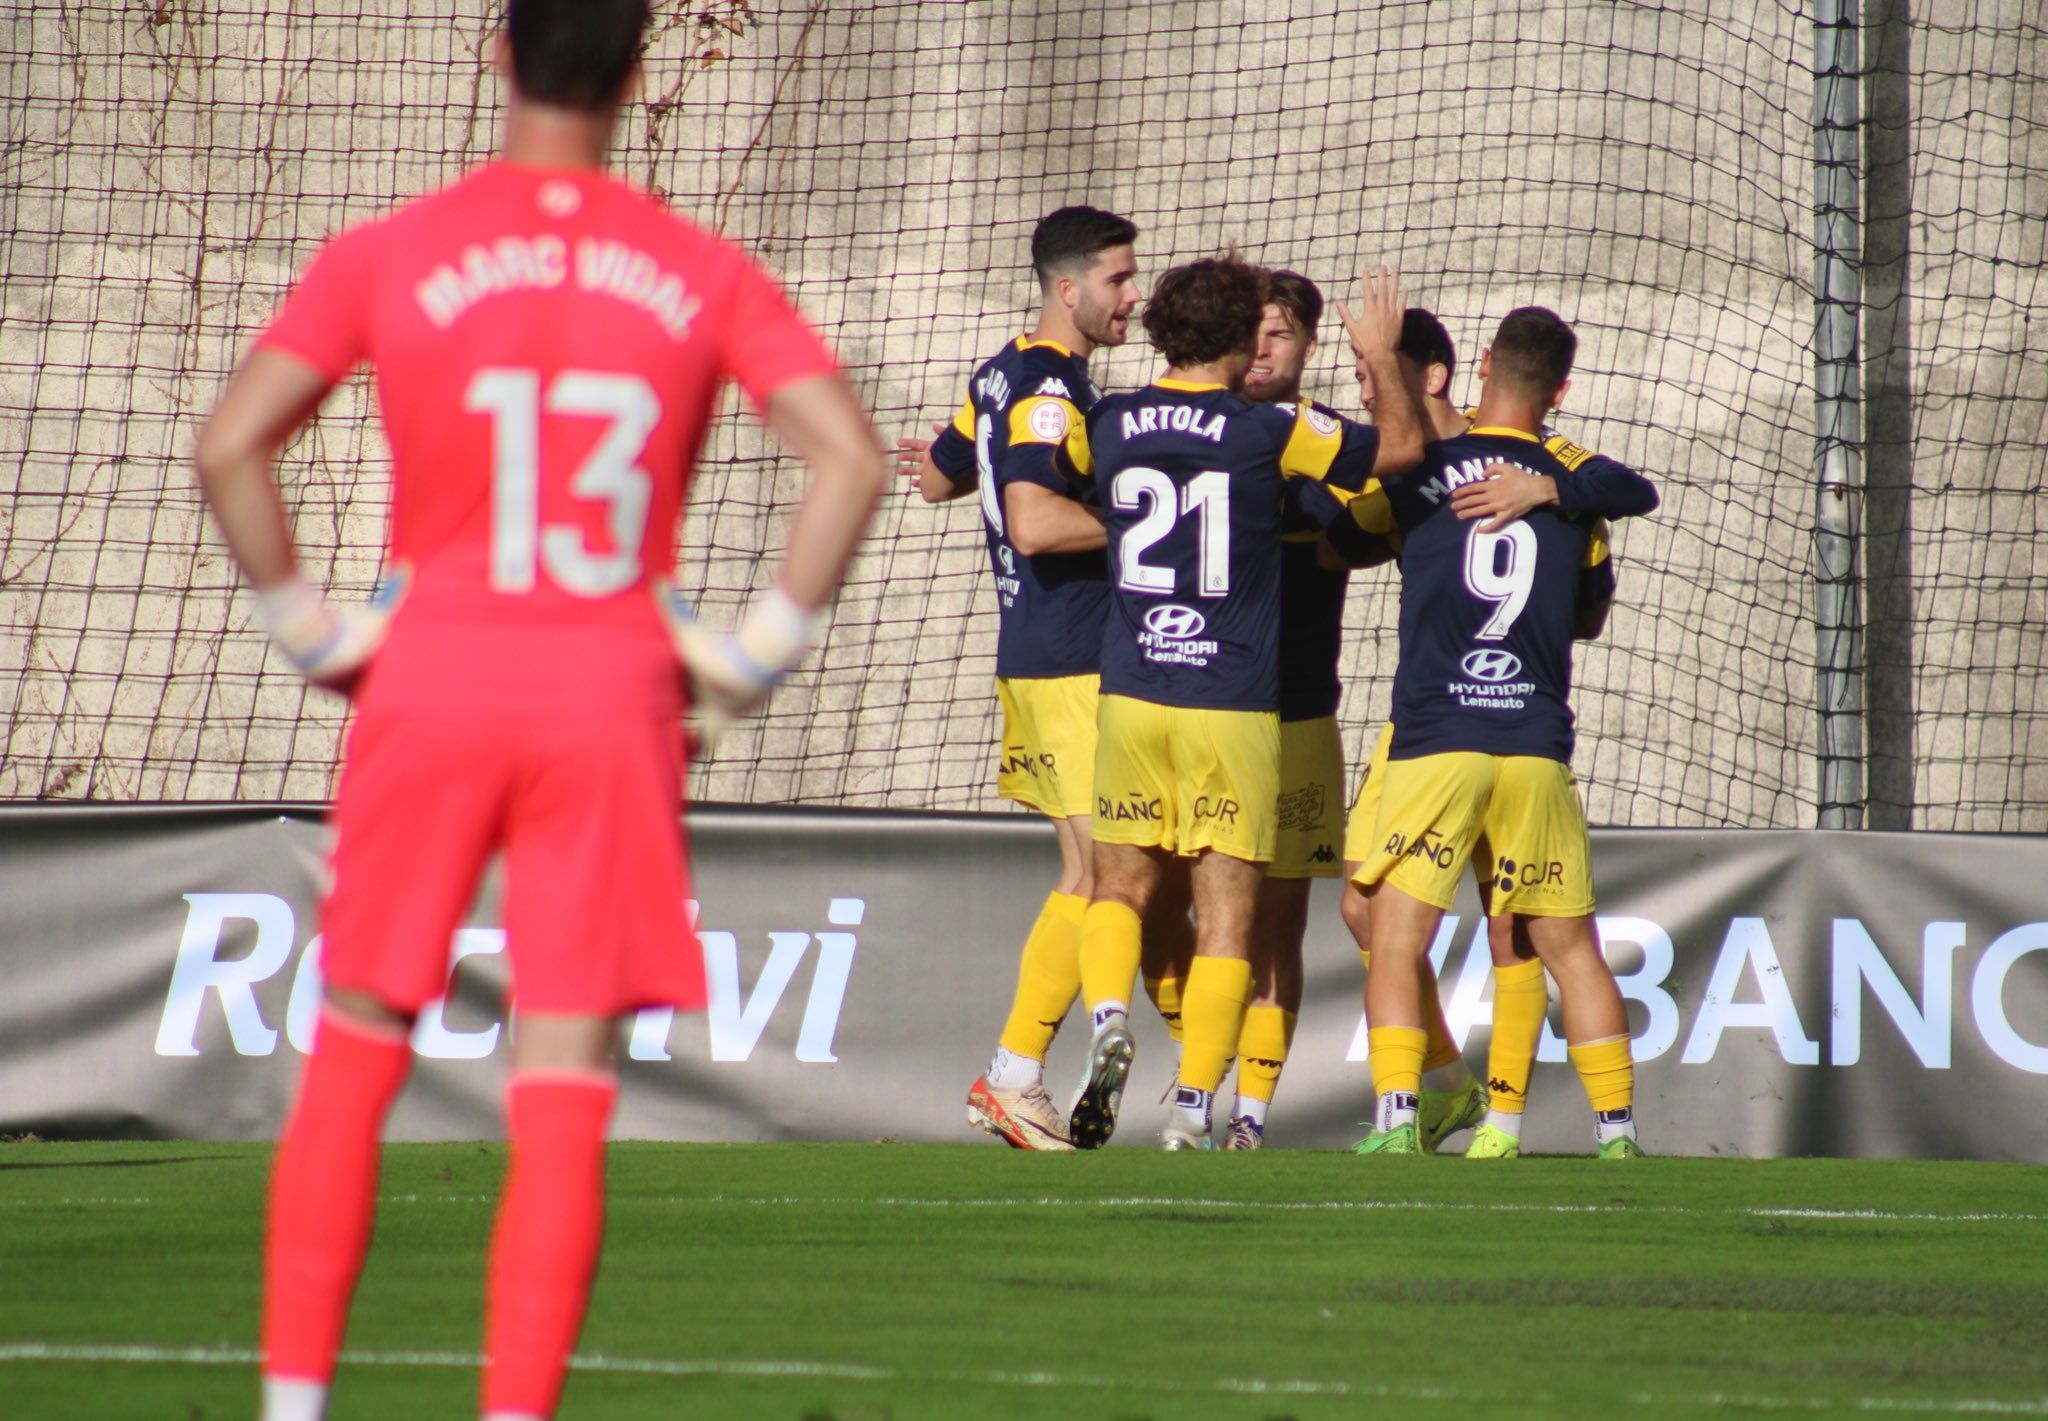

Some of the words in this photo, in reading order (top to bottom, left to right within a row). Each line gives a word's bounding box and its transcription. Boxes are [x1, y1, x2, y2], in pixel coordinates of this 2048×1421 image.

[415, 233, 567, 328] MARC
[575, 235, 703, 342] VIDAL
[1122, 405, 1227, 442] ARTOLA
[464, 366, 663, 597] 13
[1112, 466, 1230, 597] 21
[1465, 517, 1539, 640] 9
[1137, 631, 1218, 655] HYUNDAI
[1145, 647, 1208, 667] Lemauto
[1448, 682, 1536, 697] HYUNDAI
[1460, 694, 1525, 710] Lemauto
[1193, 795, 1240, 825] CJR
[1520, 861, 1564, 887] CJR
